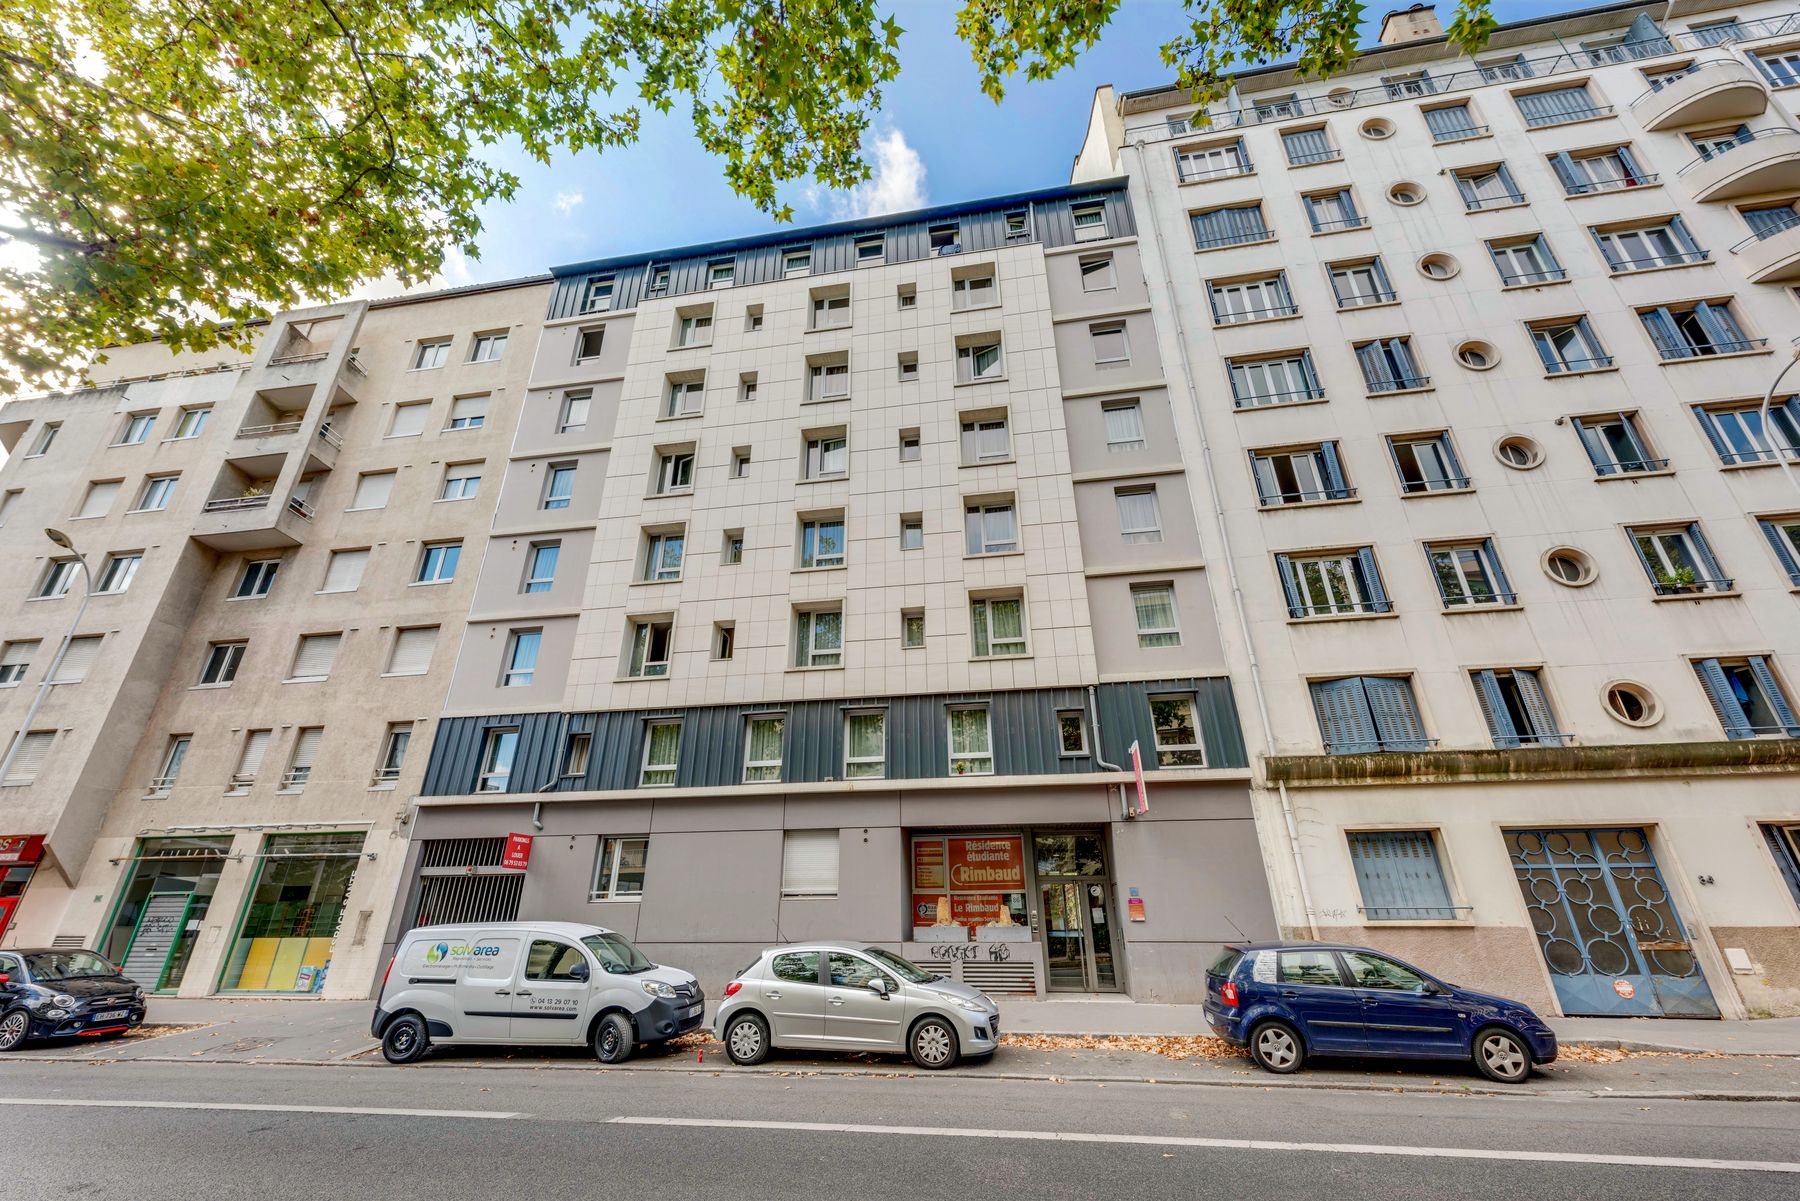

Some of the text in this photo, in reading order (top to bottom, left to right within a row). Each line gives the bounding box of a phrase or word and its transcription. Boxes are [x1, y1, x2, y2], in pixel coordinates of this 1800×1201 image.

[965, 840, 1011, 851] Résidence
[966, 851, 1010, 862] étudiante
[960, 865, 1021, 881] Rimbaud
[954, 903, 999, 912] Le Rimbaud
[329, 908, 345, 952] ESPACE
[450, 944, 500, 956] solvarea
